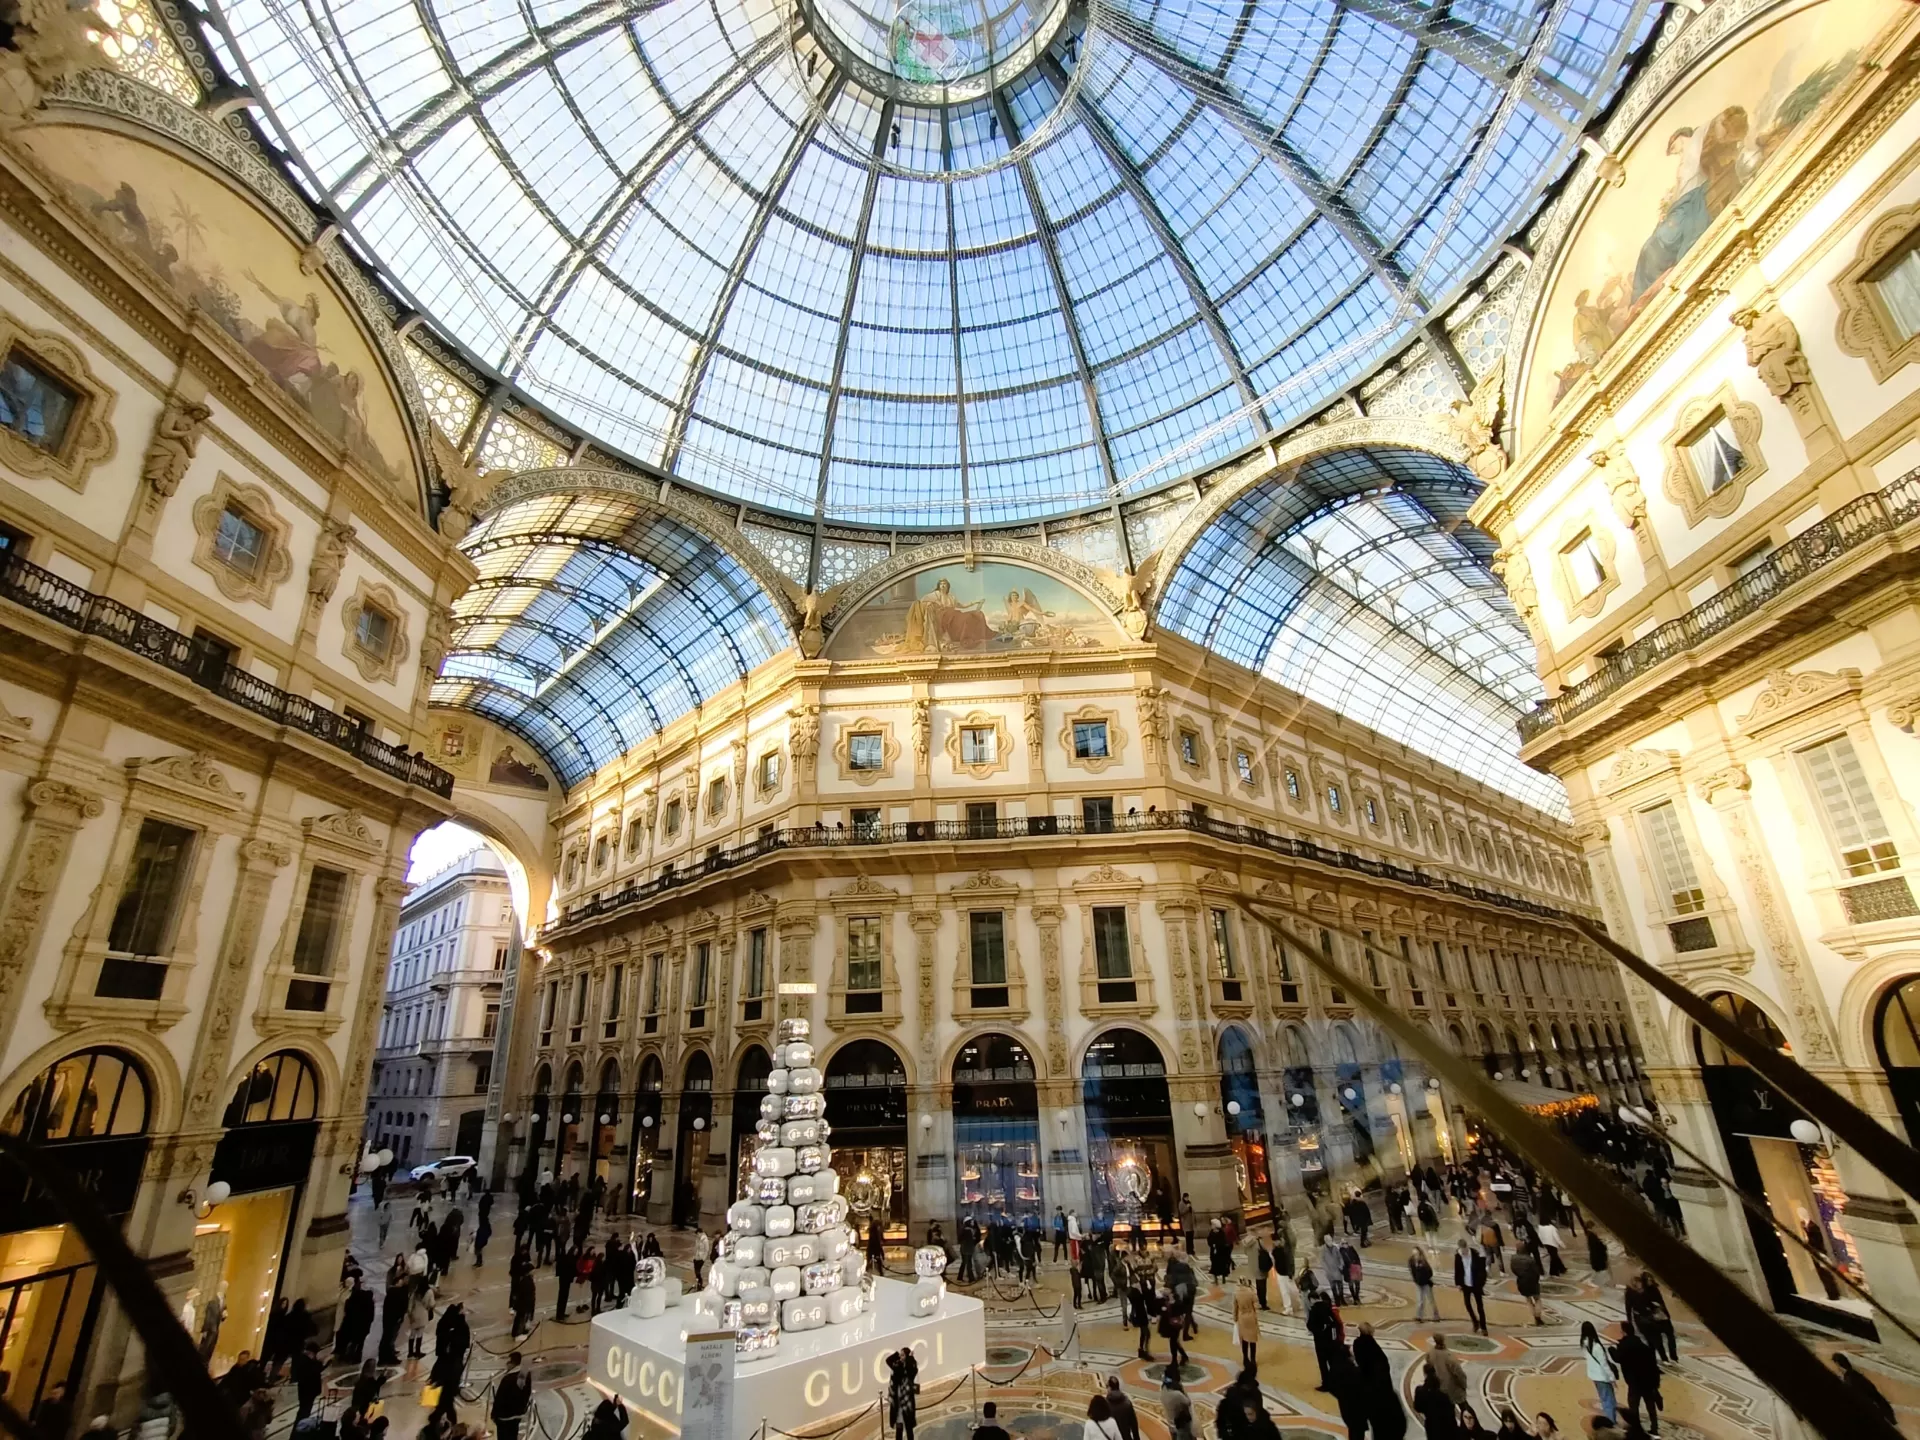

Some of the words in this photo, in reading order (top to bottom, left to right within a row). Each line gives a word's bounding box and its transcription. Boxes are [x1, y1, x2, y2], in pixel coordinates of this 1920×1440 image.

[975, 1098, 1014, 1109] PRADA
[1107, 1094, 1146, 1103] PRAA
[607, 1345, 685, 1416] GUCCI
